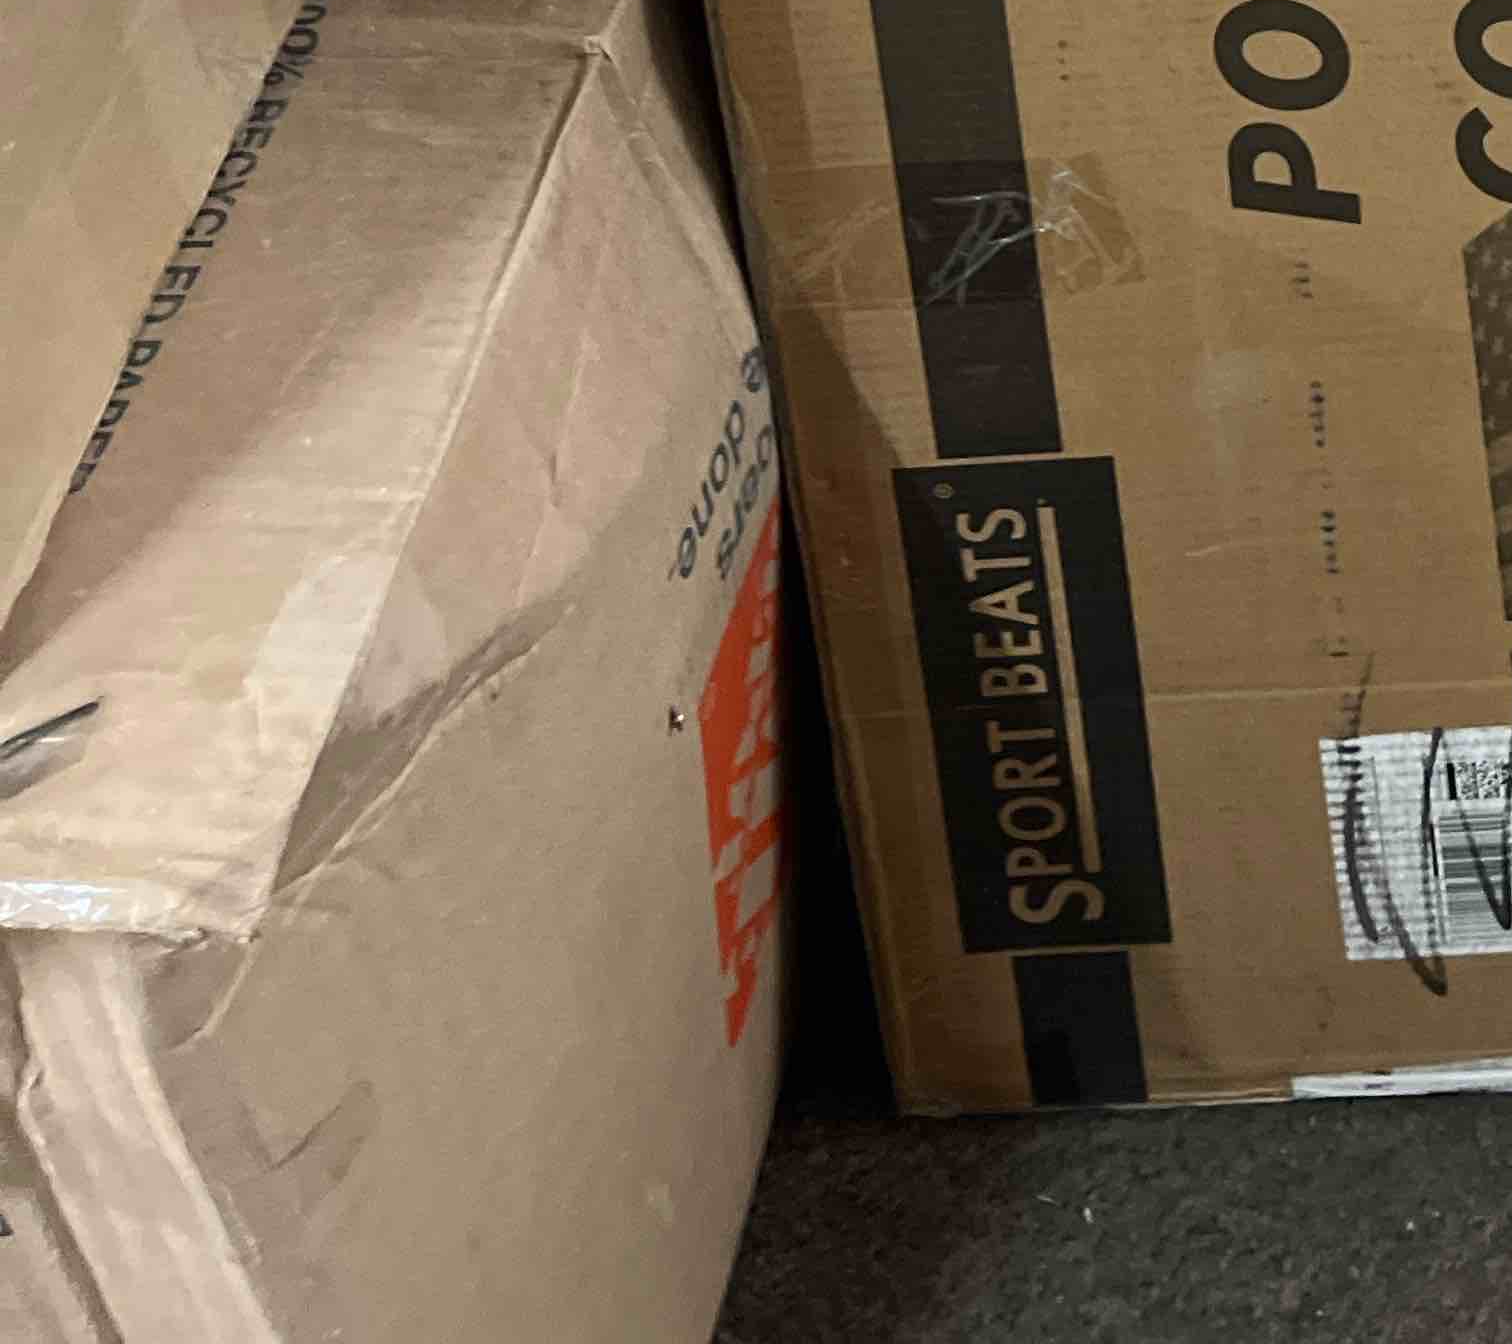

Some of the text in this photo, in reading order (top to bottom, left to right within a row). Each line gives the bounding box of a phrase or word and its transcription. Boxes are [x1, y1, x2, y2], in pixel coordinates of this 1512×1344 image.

[134, 94, 290, 334] RECYCLED
[955, 506, 1106, 925] SPORT BEATS
